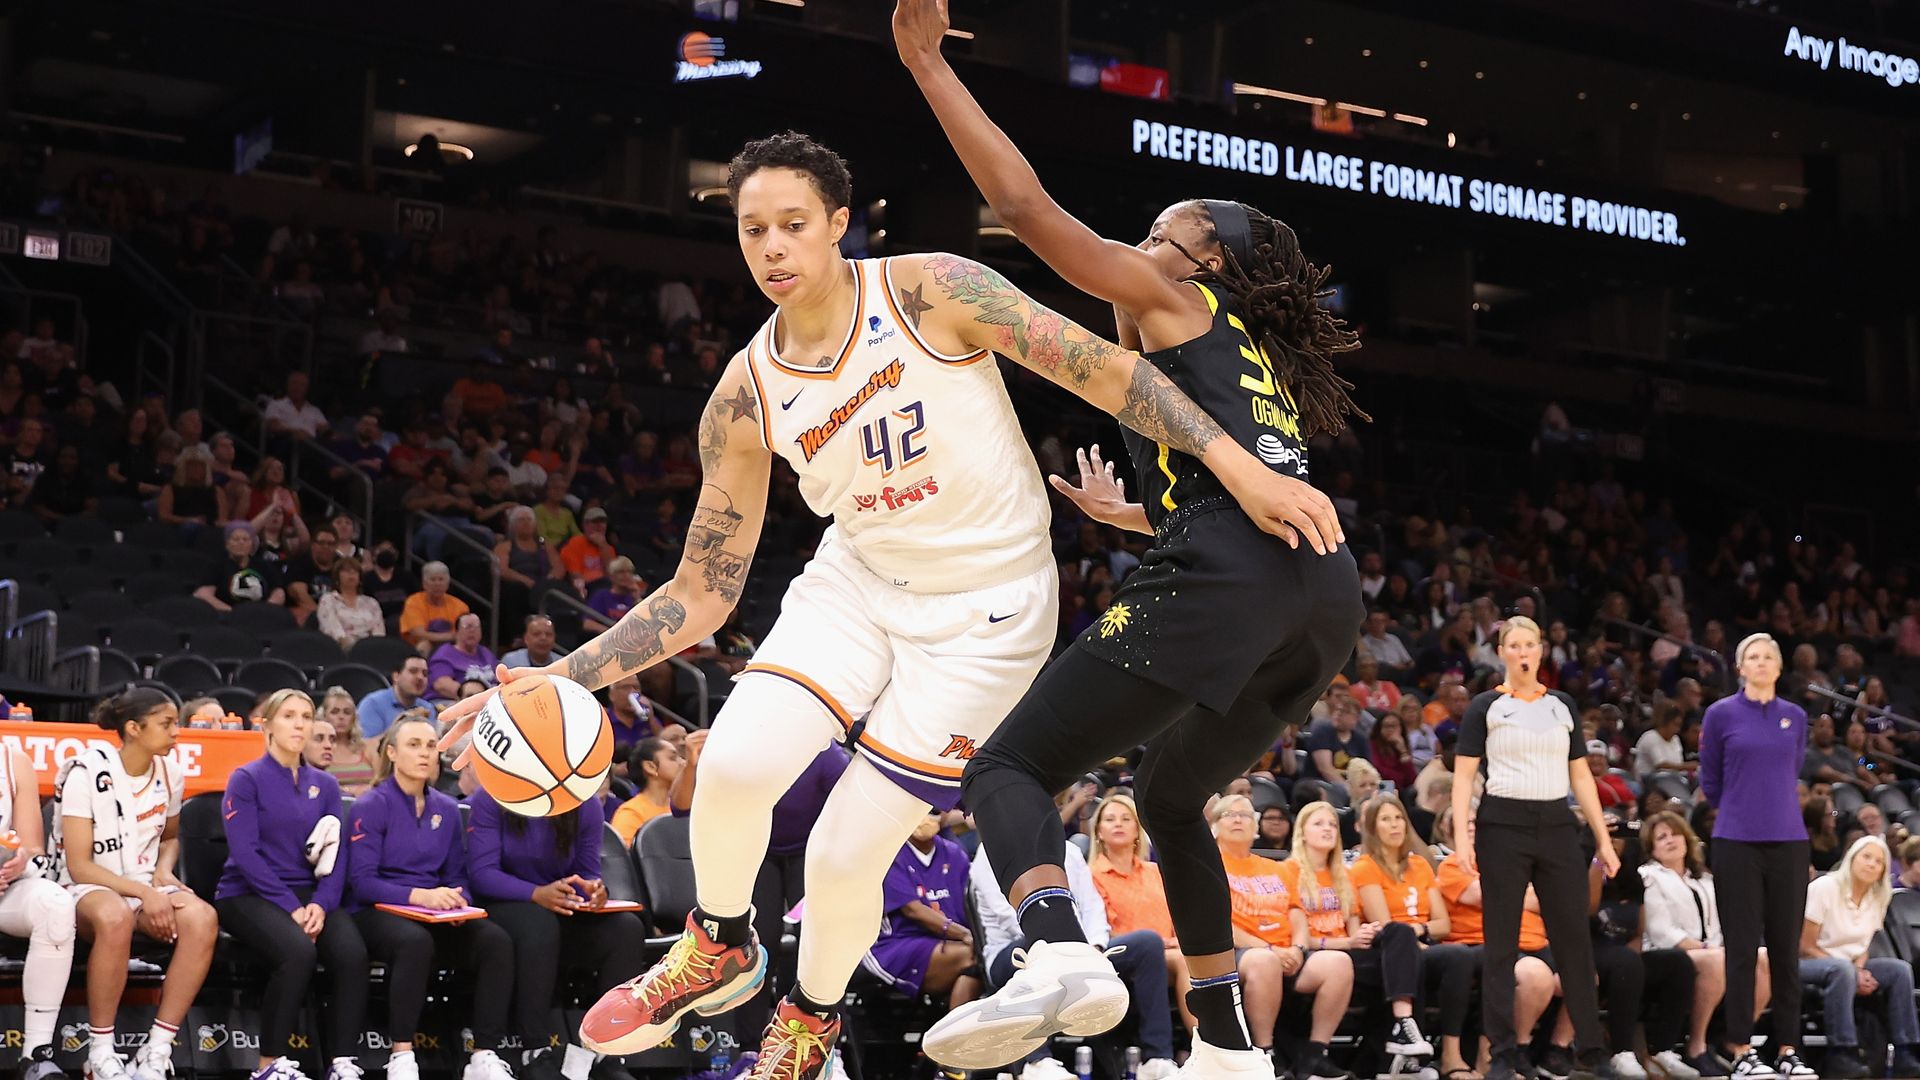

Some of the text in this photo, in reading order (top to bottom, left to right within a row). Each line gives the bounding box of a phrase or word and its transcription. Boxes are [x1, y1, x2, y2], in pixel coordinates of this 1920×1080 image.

[1783, 26, 1920, 87] Any Image
[1132, 118, 1687, 247] PREFERRED LARGE FORMAT SIGNAGE PROVIDER.
[867, 328, 896, 347] PayPal
[794, 357, 905, 464] Mercury
[858, 400, 930, 479] 42
